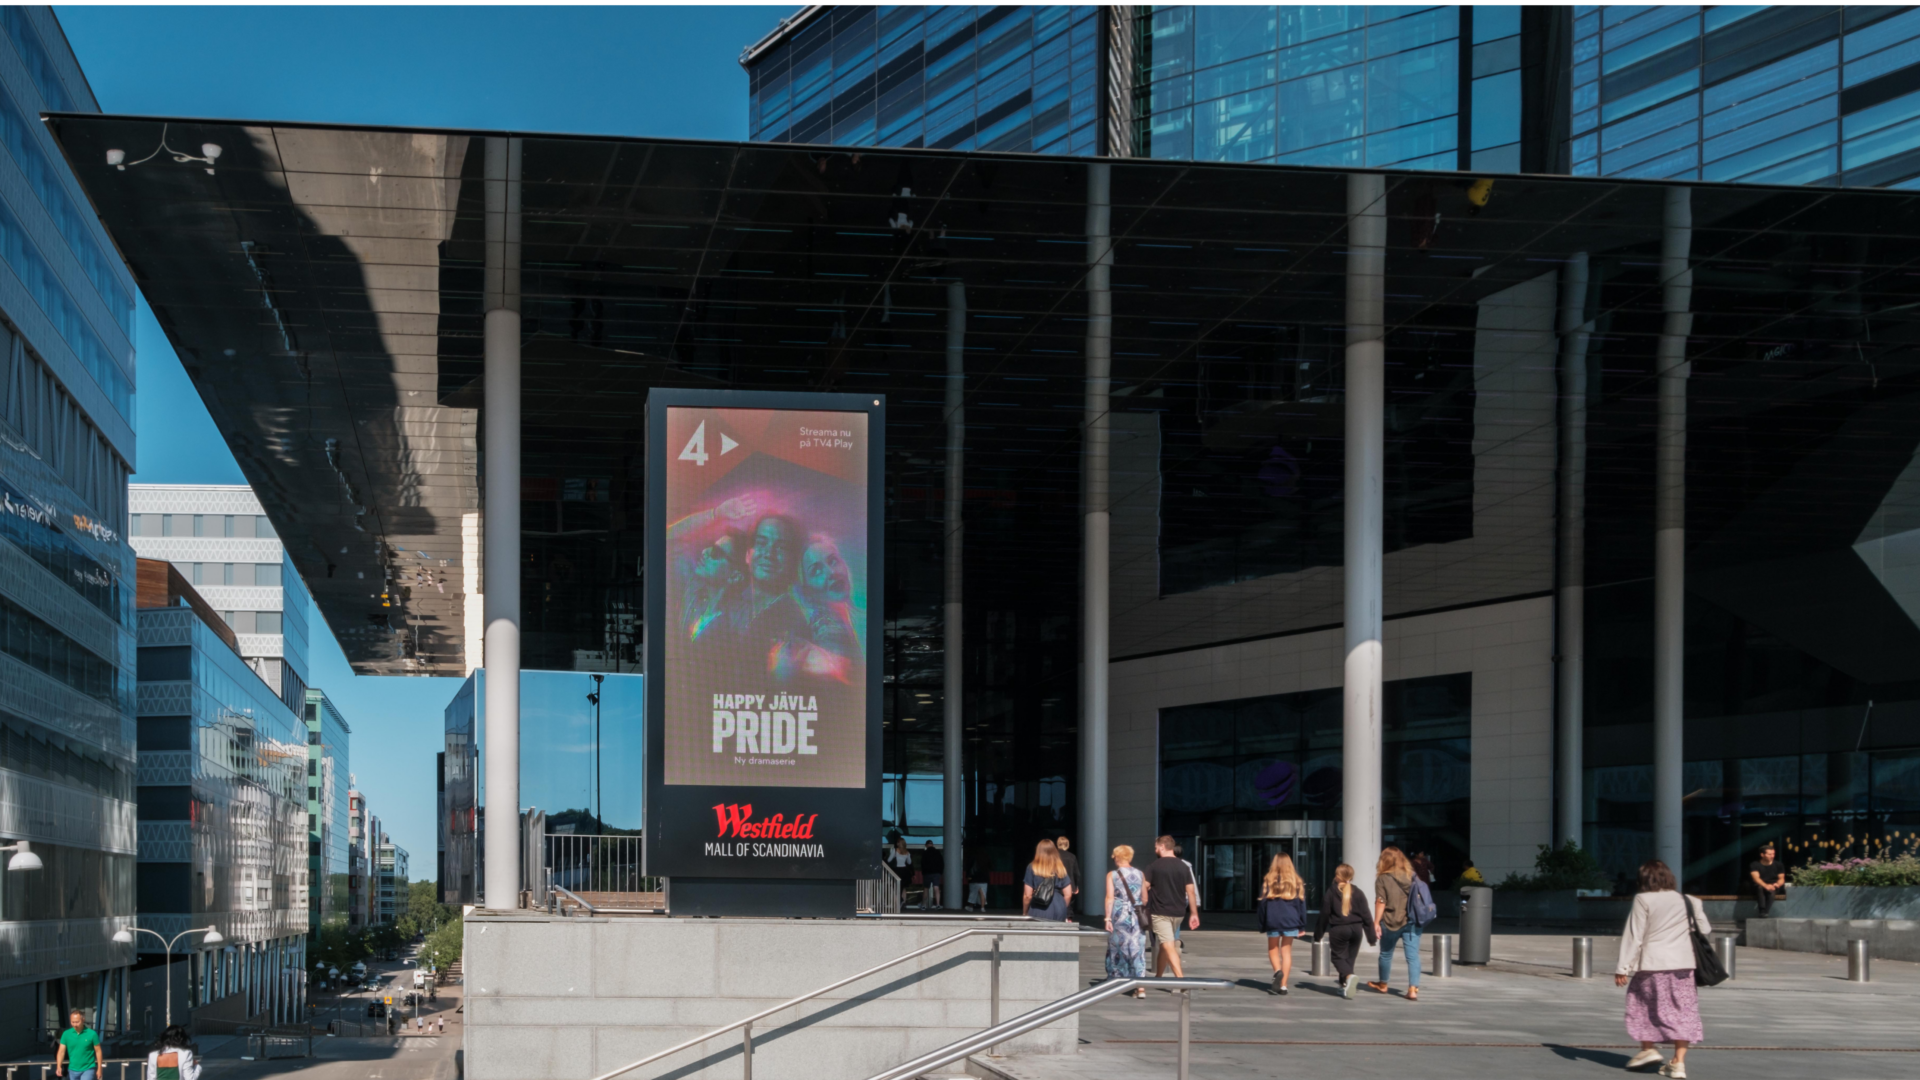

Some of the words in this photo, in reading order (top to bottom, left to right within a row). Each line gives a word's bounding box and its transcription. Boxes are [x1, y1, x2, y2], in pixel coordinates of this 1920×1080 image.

[800, 426, 838, 437] Streama
[840, 429, 852, 437] nu
[800, 438, 811, 449] på
[813, 439, 832, 448] TV4
[834, 439, 853, 450] Play
[713, 694, 765, 710] HAPPY
[769, 691, 818, 711] JÄVLA
[712, 710, 818, 755] PRIDE
[734, 756, 746, 766] Ny
[748, 756, 796, 766] dramaserie
[712, 803, 819, 840] Westfield
[705, 842, 734, 857] MALL
[736, 843, 750, 857] OF
[752, 843, 825, 858] SCANDINAVIA
